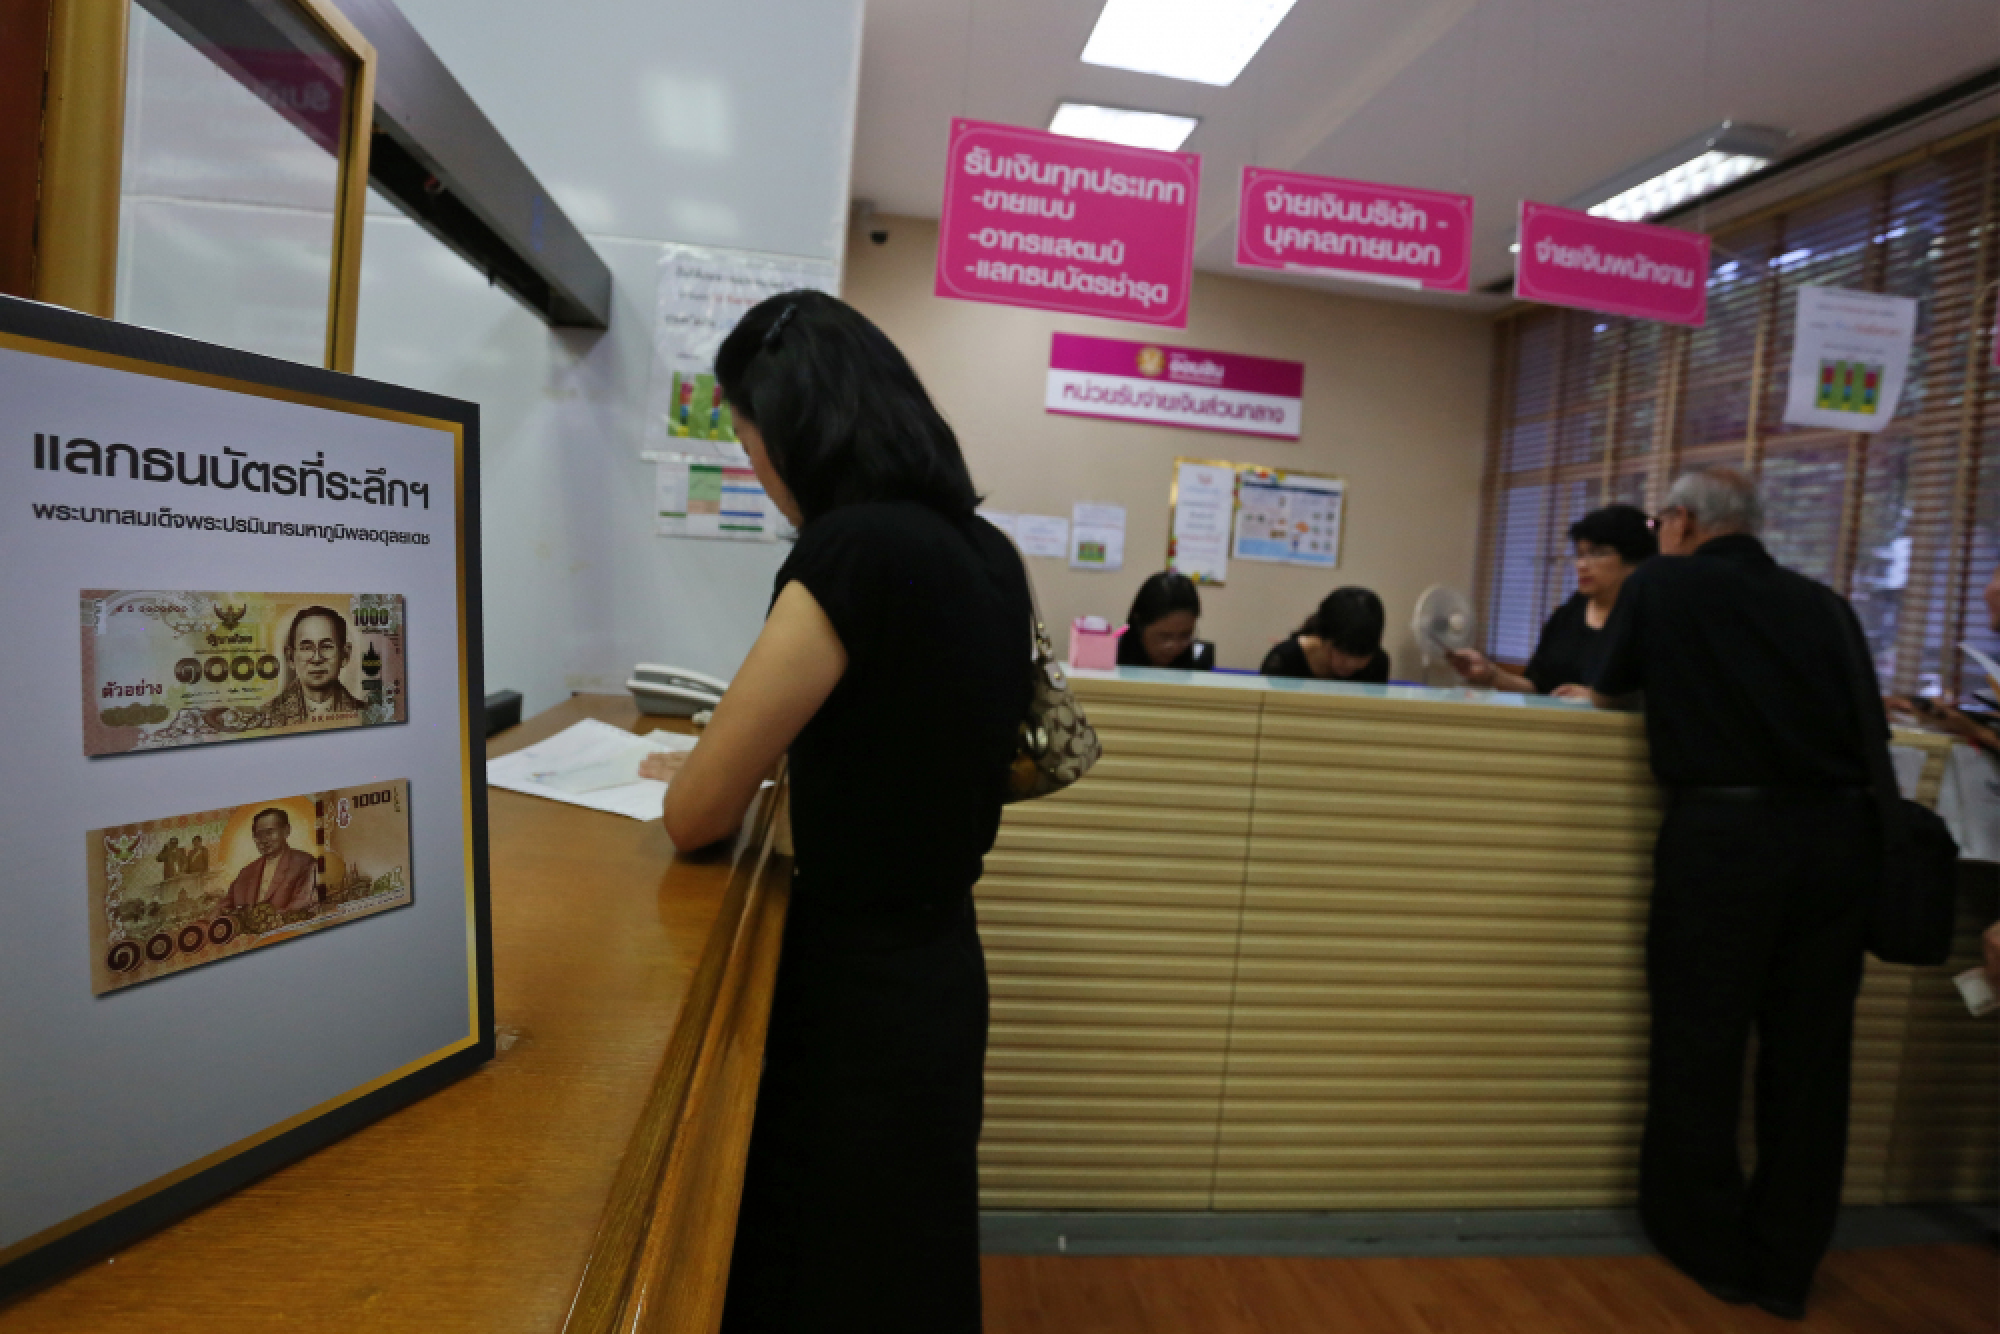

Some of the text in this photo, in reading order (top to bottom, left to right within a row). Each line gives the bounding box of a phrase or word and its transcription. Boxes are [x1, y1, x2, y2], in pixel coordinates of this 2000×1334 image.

[964, 146, 1186, 206] รับเงินทุกประเภท
[972, 189, 1077, 221] -ขายแบบ
[967, 227, 1126, 266] -อากรแสตมป์
[1263, 223, 1442, 268] บุคคลภายนอก
[1534, 234, 1696, 290] จ่ายเงินพนักงาน
[33, 432, 431, 511] แลกธนบัตรที่ระลึกฯ
[31, 502, 431, 546] พระบาทสมเด็จพระปรมินทรมหาภูมิพลอดุลยเดช
[101, 679, 163, 698] ตัวอย่าง
[352, 789, 391, 809] 1000
